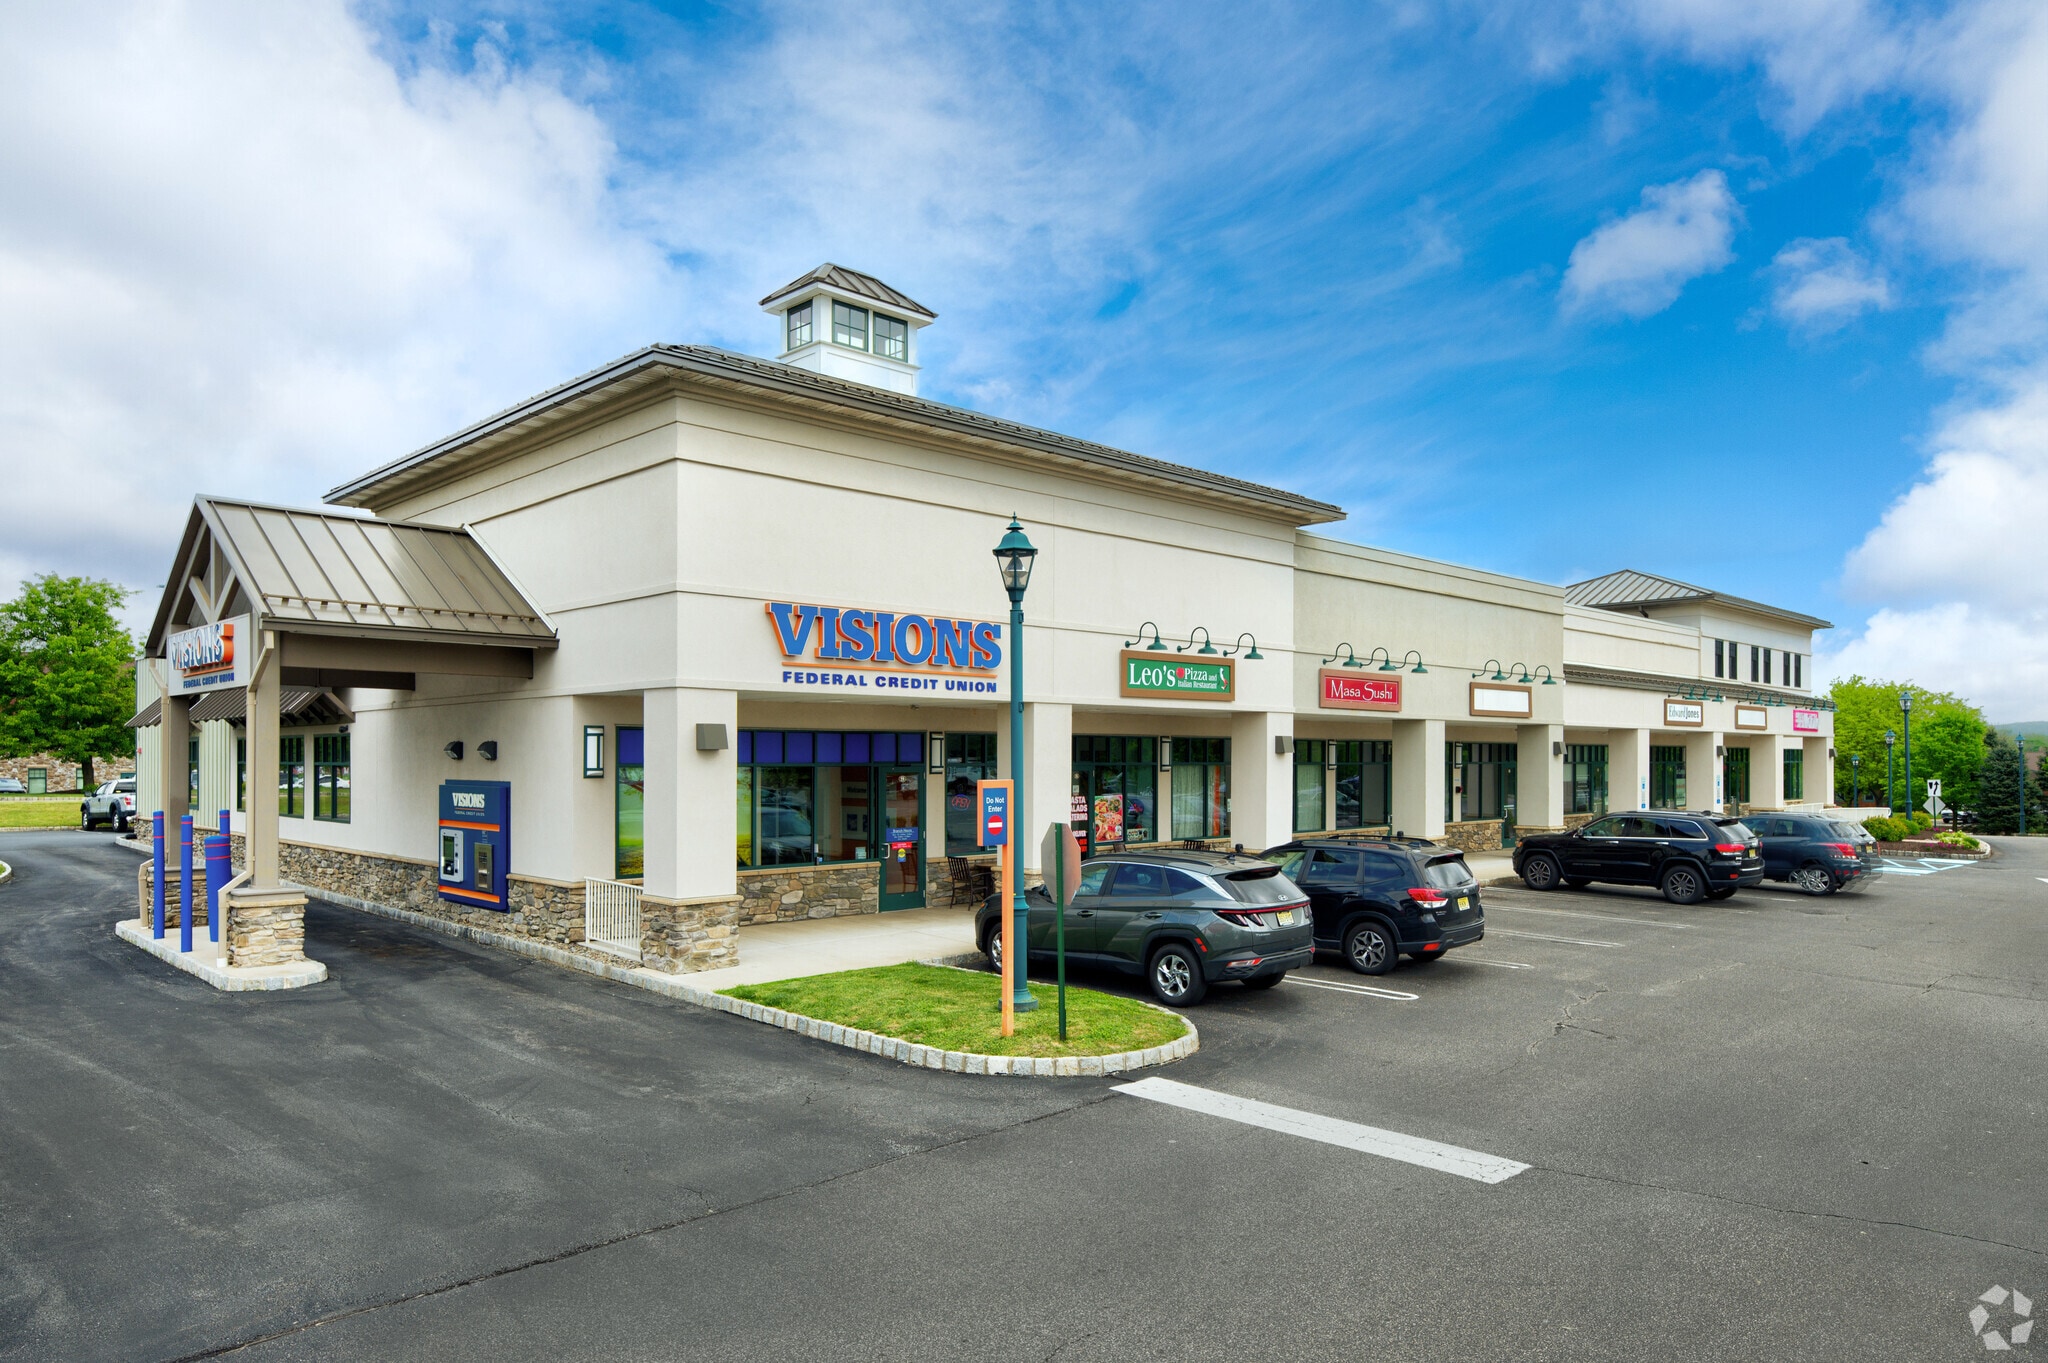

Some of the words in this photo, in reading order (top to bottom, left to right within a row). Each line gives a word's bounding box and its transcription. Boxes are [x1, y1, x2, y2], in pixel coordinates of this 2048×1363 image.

[765, 602, 1002, 669] VISIONS
[169, 623, 234, 671] VISIONS
[183, 678, 201, 689] FEDERAL
[202, 675, 218, 686] CREDIT
[219, 672, 235, 683] UNION
[782, 671, 868, 687] FEDERAL
[875, 675, 938, 690] CREDIT
[945, 680, 997, 693] UNION
[1129, 663, 1176, 688] Leo's
[1184, 667, 1208, 681] Pizza
[1178, 680, 1192, 688] Italian
[1331, 679, 1360, 698] Masa
[1362, 682, 1393, 701] Sushi
[452, 792, 485, 808] VISIONS
[1071, 796, 1086, 804] ASTA
